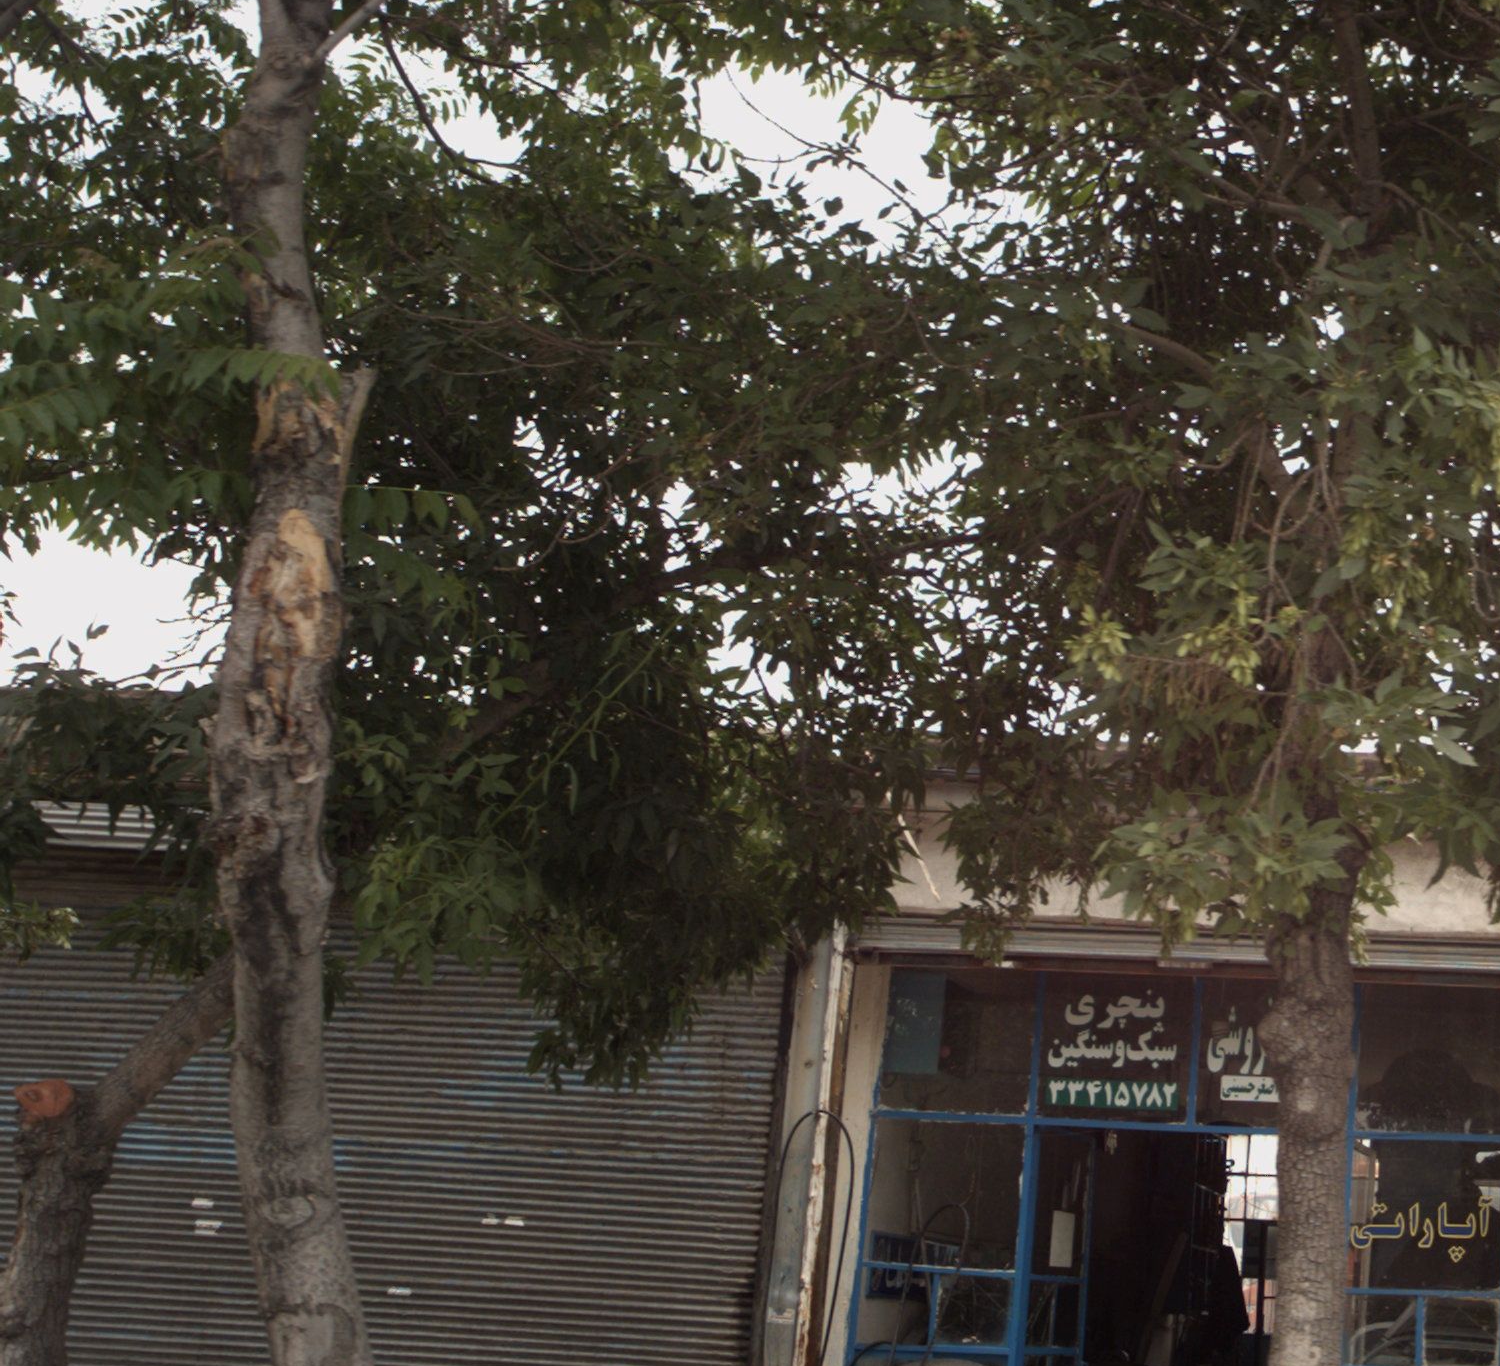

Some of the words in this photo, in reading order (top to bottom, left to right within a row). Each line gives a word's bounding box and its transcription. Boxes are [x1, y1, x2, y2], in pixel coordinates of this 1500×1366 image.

[1064, 989, 1166, 1033] پنچری
[1047, 1029, 1114, 1068] سنگین
[1126, 1032, 1178, 1069] سبک
[1206, 997, 1273, 1075] روشی
[1048, 1079, 1178, 1108] ۳۳۴۱۵۷۸۲
[1350, 1196, 1493, 1263] آپاراتی
